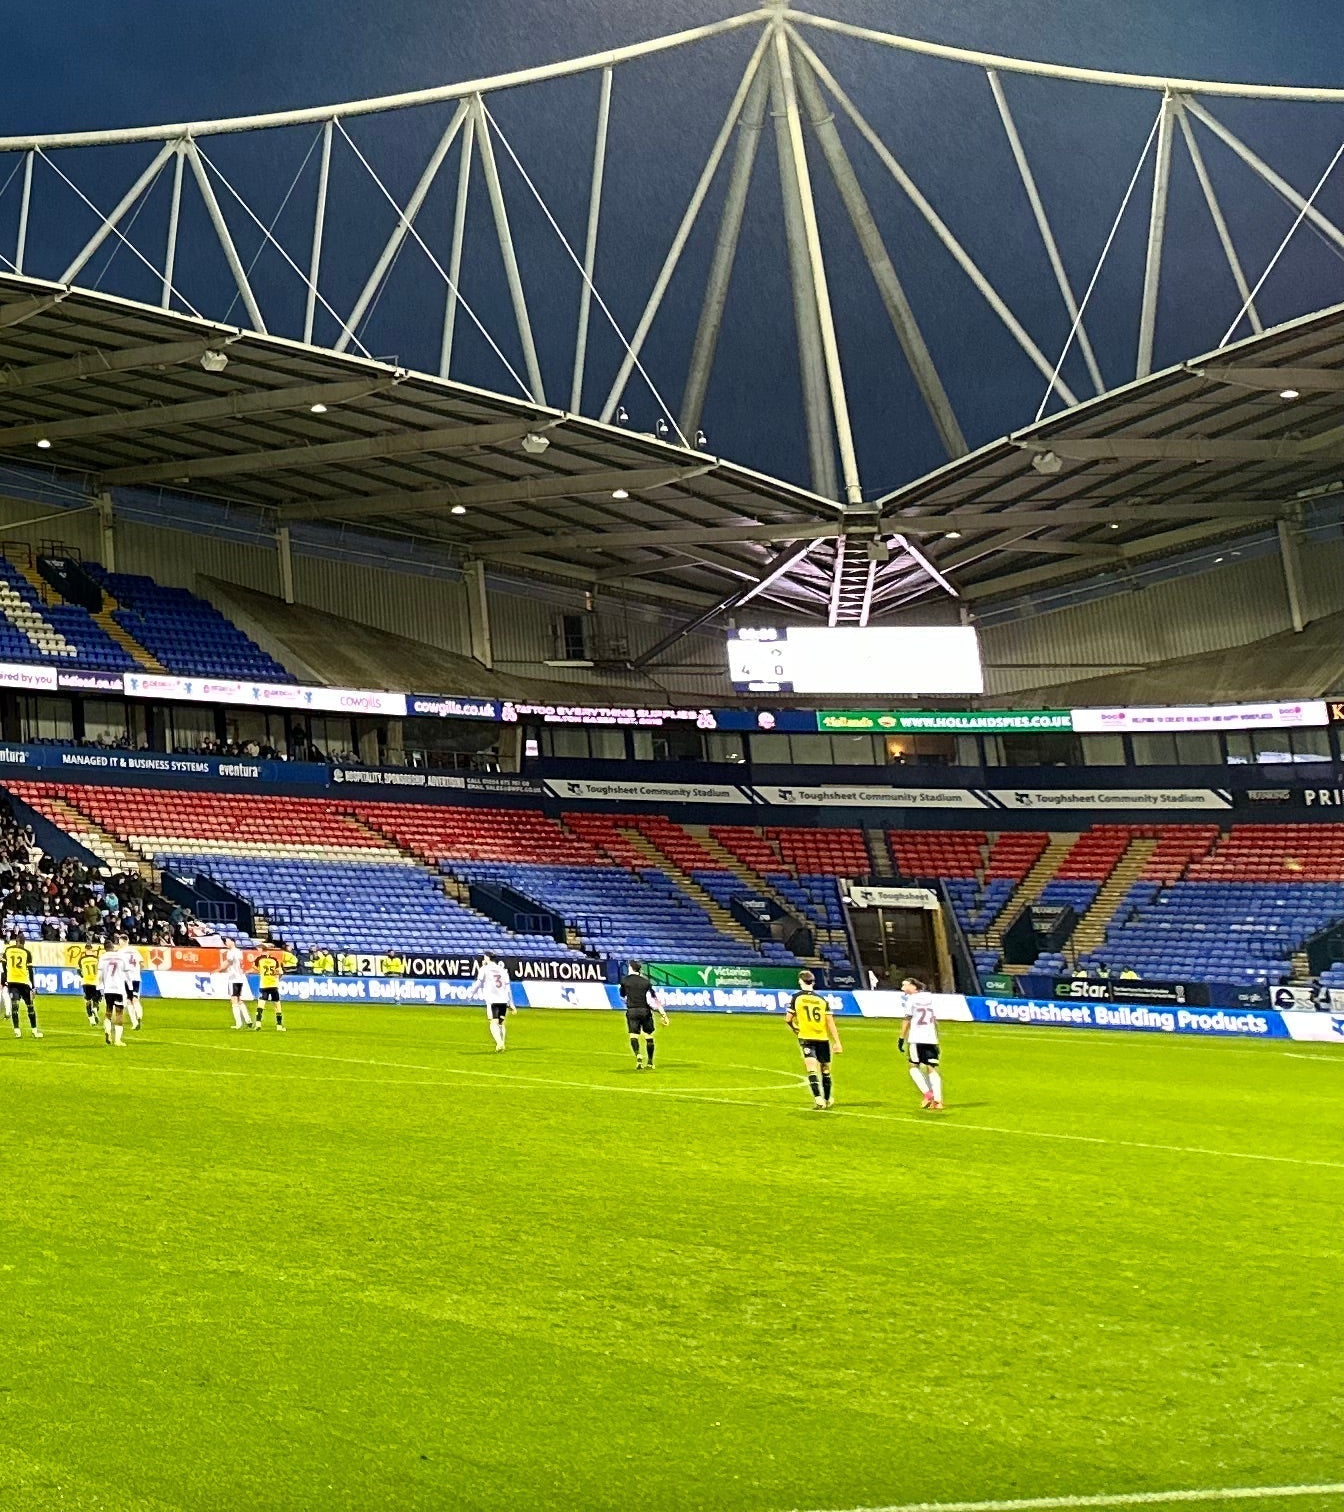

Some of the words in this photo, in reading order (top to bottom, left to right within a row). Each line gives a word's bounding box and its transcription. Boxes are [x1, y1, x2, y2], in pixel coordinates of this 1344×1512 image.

[21, 672, 33, 685] by
[35, 674, 53, 686] you
[340, 695, 382, 711] cowgills
[414, 699, 495, 717] cowgills.co.uk
[515, 704, 555, 715] TATTOO
[557, 706, 634, 719] EVERYTHING
[635, 709, 698, 720] SUPPLIES
[900, 715, 1071, 729] WWW.HOLLANDSPIES.CO.UK
[63, 754, 108, 767] MANAGED
[110, 756, 118, 768] IT
[120, 757, 127, 768] &
[128, 758, 169, 771] BUSINESS
[171, 760, 210, 773] SYSTEMS
[219, 763, 258, 778] eventura
[586, 785, 639, 798] Toughsheet
[640, 787, 692, 798] Community
[694, 787, 730, 798] Stadium
[799, 790, 857, 802] Toughsheet
[859, 792, 918, 804] Community
[920, 791, 962, 802] Stadium
[1036, 794, 1096, 805] Toughsheet
[1098, 795, 1158, 806] Community
[1160, 794, 1205, 804] Stadium
[878, 892, 929, 901] Toughsheet
[9, 955, 23, 969] 12
[127, 954, 137, 967] 4
[85, 964, 96, 976] 11
[106, 961, 115, 977] 7
[263, 964, 275, 976] 25
[515, 961, 606, 981] JANITORIAL
[714, 967, 751, 977] victorian
[492, 974, 503, 988] 3
[369, 979, 437, 1002] Building
[1056, 981, 1109, 998] eStar.
[713, 989, 776, 1011] Building
[802, 1004, 822, 1023] 16
[985, 999, 1092, 1022] Toughsheet
[1094, 1006, 1175, 1032] Building
[1177, 1011, 1268, 1034] Products
